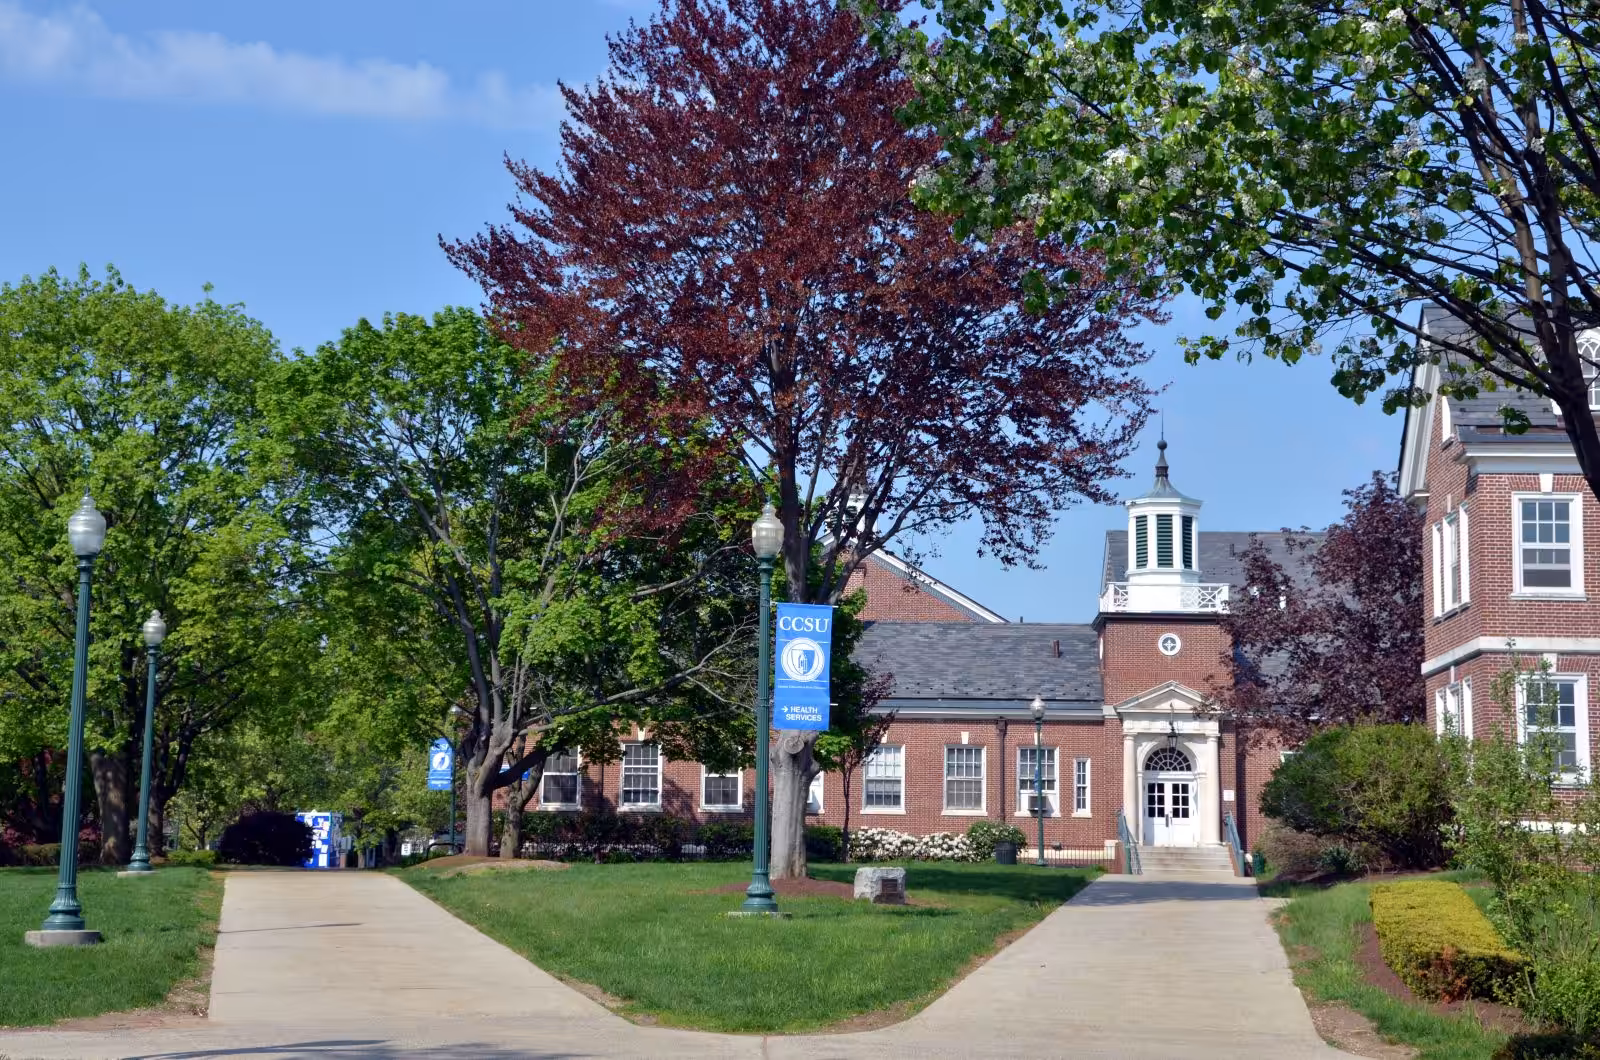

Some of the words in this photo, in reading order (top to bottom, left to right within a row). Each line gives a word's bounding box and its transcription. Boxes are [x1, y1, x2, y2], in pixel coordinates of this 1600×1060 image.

[779, 616, 830, 632] CCSU
[790, 706, 818, 714] HEALTH
[785, 713, 822, 721] SERVICES
